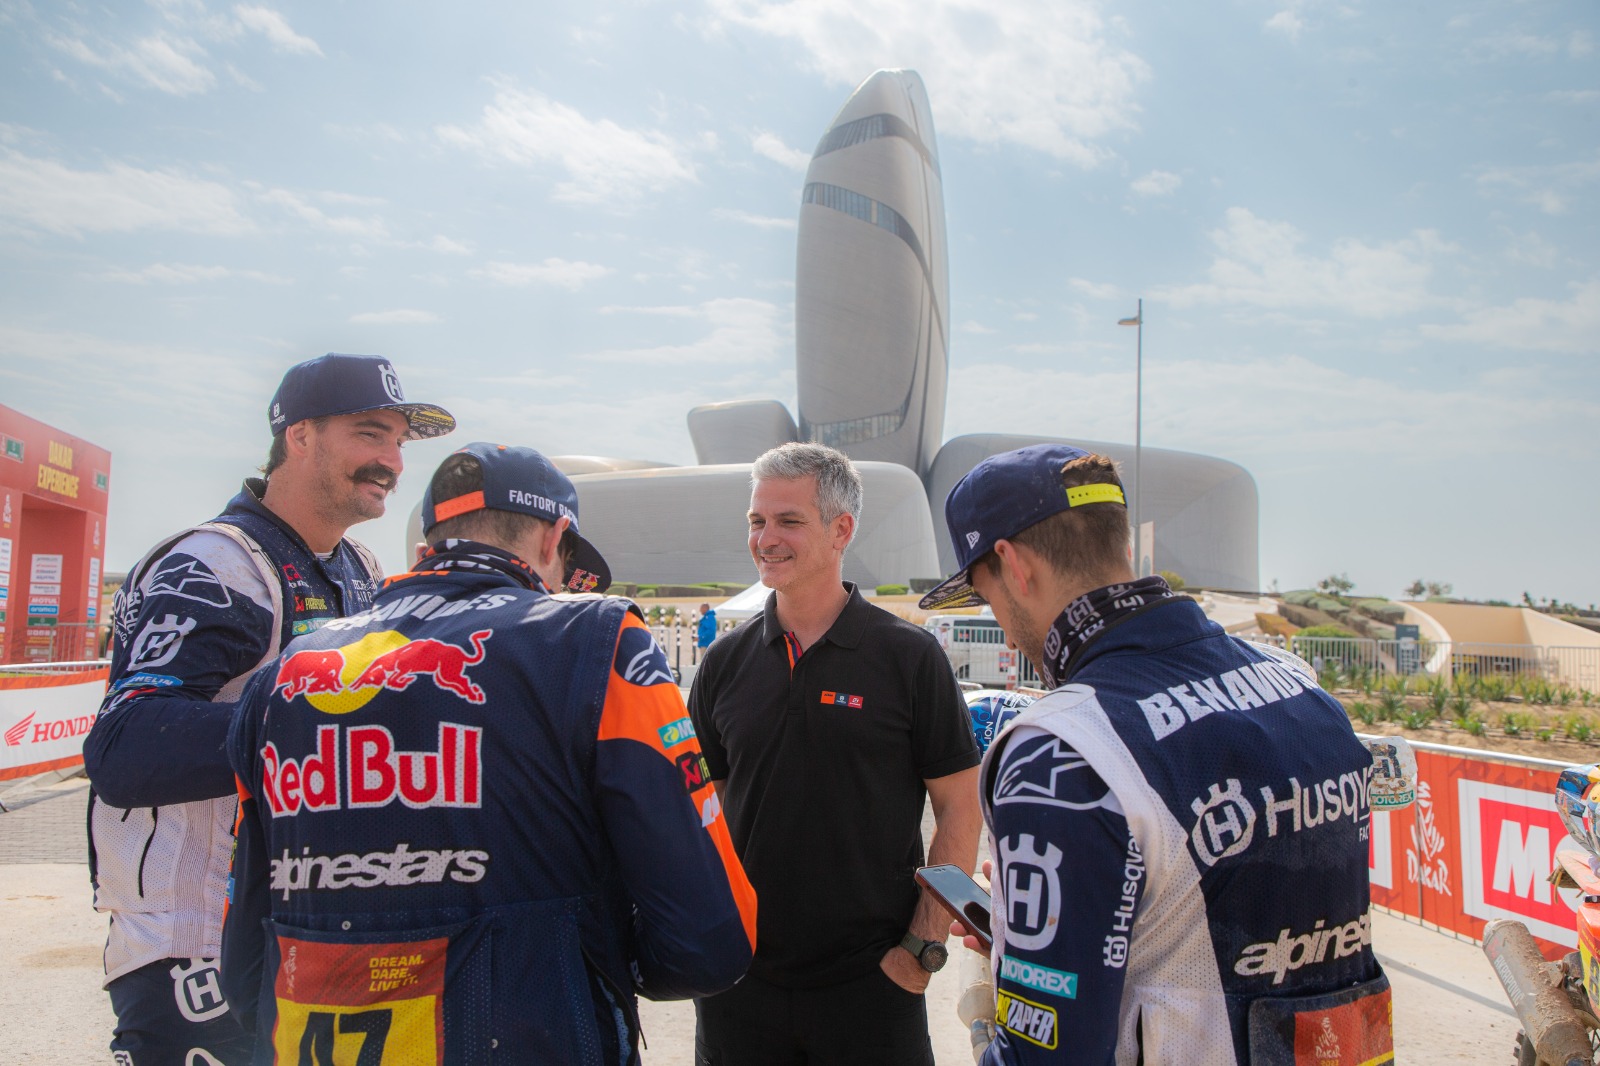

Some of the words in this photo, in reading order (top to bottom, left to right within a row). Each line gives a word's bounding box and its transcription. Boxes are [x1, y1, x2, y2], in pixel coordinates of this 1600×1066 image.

[49, 440, 73, 470] DAKAR
[37, 464, 79, 498] EXPERIENCE
[508, 489, 557, 514] FACTORY
[260, 724, 341, 818] Red
[347, 721, 483, 809] Bull
[270, 843, 490, 901] alpinestars
[369, 954, 425, 968] DREAM.
[371, 967, 412, 979] DARE.
[1001, 956, 1072, 995] MOTOREX
[368, 979, 400, 992] LIVE
[402, 975, 418, 987] IT.
